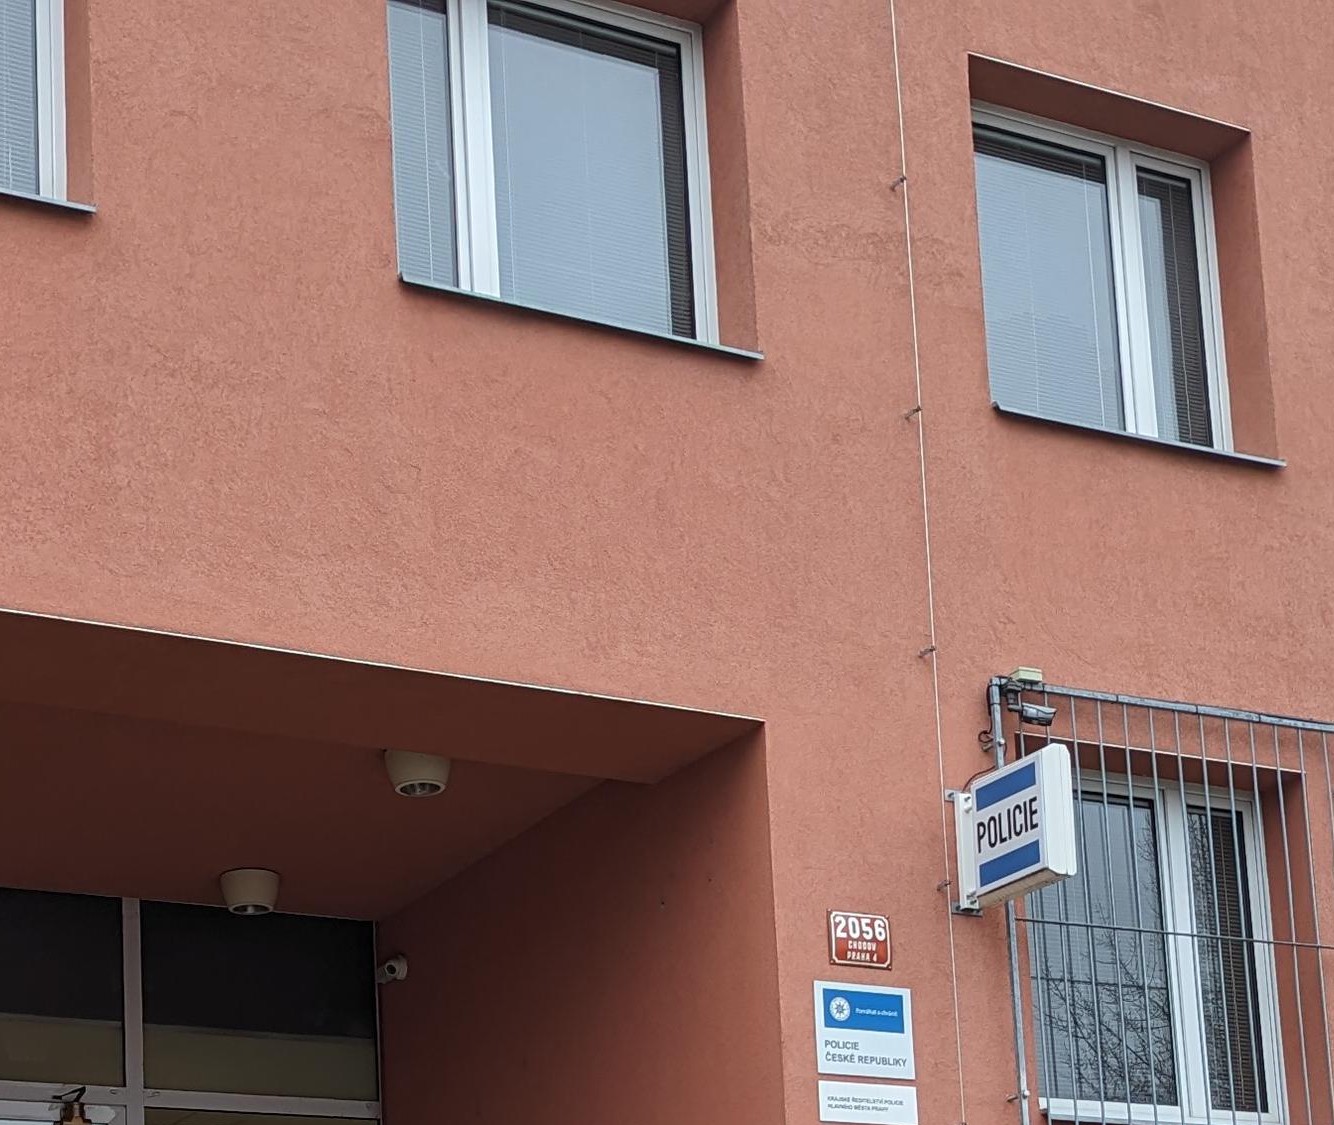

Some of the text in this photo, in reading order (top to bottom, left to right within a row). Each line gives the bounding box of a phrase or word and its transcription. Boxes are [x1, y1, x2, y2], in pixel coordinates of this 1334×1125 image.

[977, 796, 1039, 853] POLICIE
[835, 916, 886, 941] 2056
[848, 940, 877, 951] CHODOV
[847, 951, 878, 962] PRAHA 4
[824, 1040, 860, 1051] POLICIE
[825, 1051, 907, 1067] ČESKÉ REPUBLIKY
